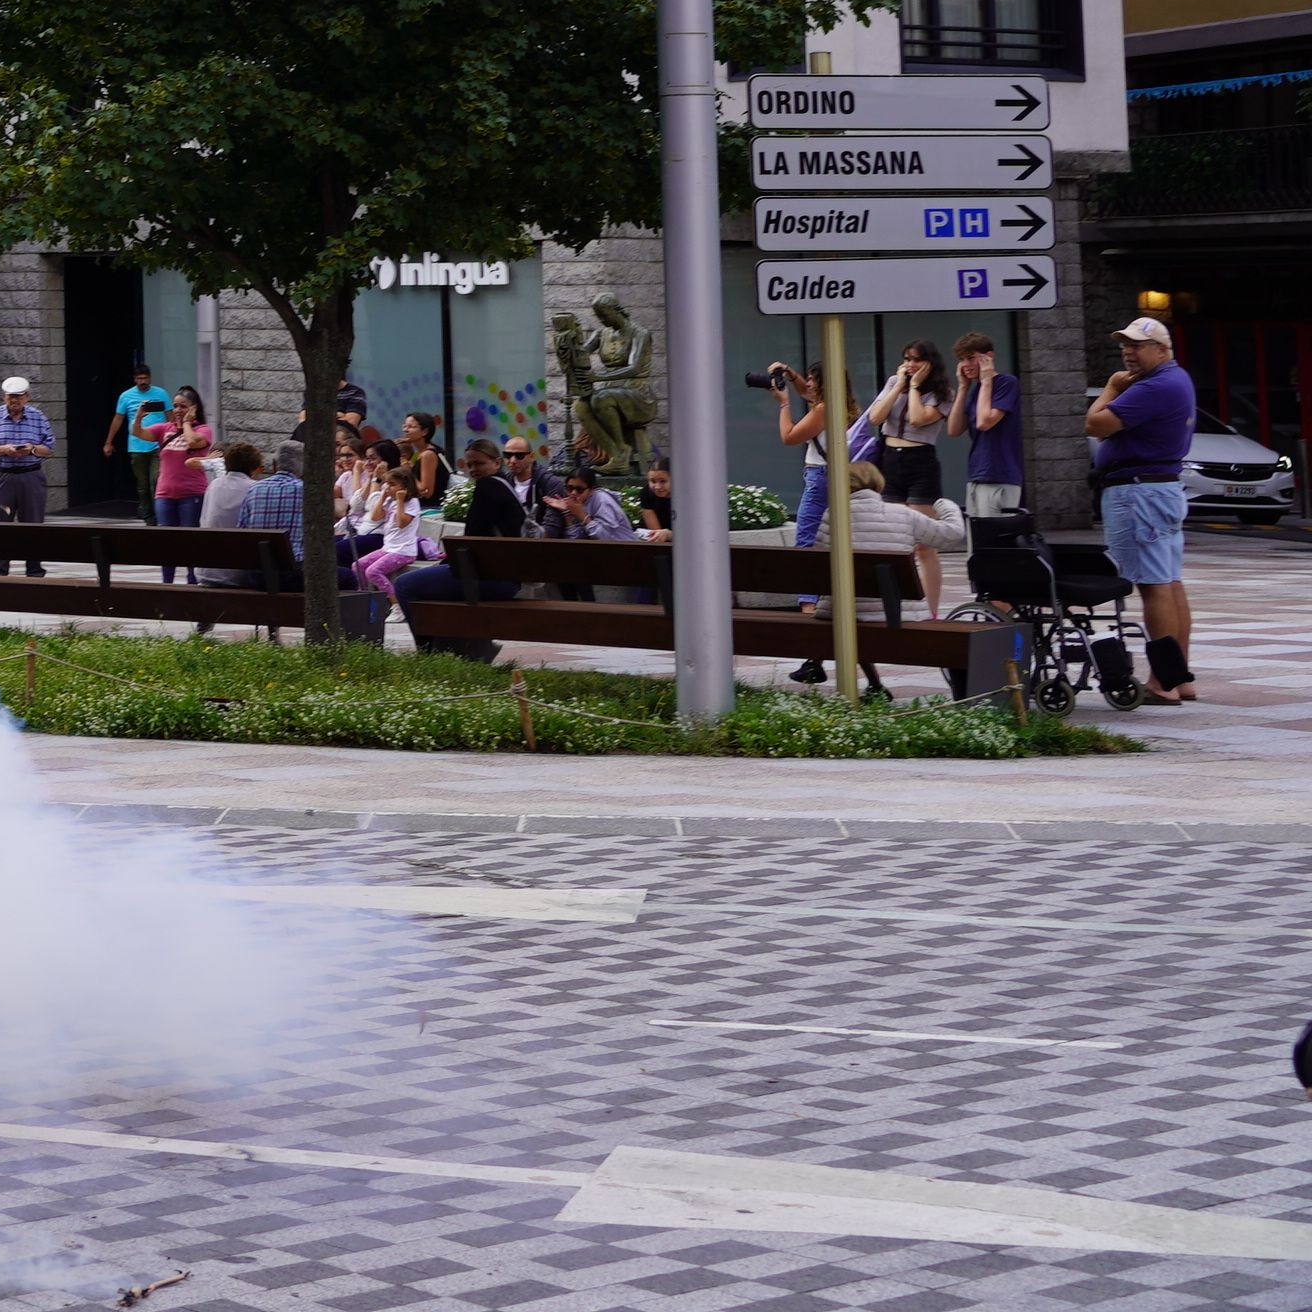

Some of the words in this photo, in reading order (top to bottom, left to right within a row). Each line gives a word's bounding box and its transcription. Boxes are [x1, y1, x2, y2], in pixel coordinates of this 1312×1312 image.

[757, 90, 856, 115] ORDINO
[759, 151, 790, 175] LA
[799, 151, 925, 175] MASSANA
[763, 209, 870, 239] Hospital
[929, 211, 949, 236] P
[399, 251, 511, 295] inlingua
[767, 276, 856, 301] Caldea
[962, 271, 983, 296] P
